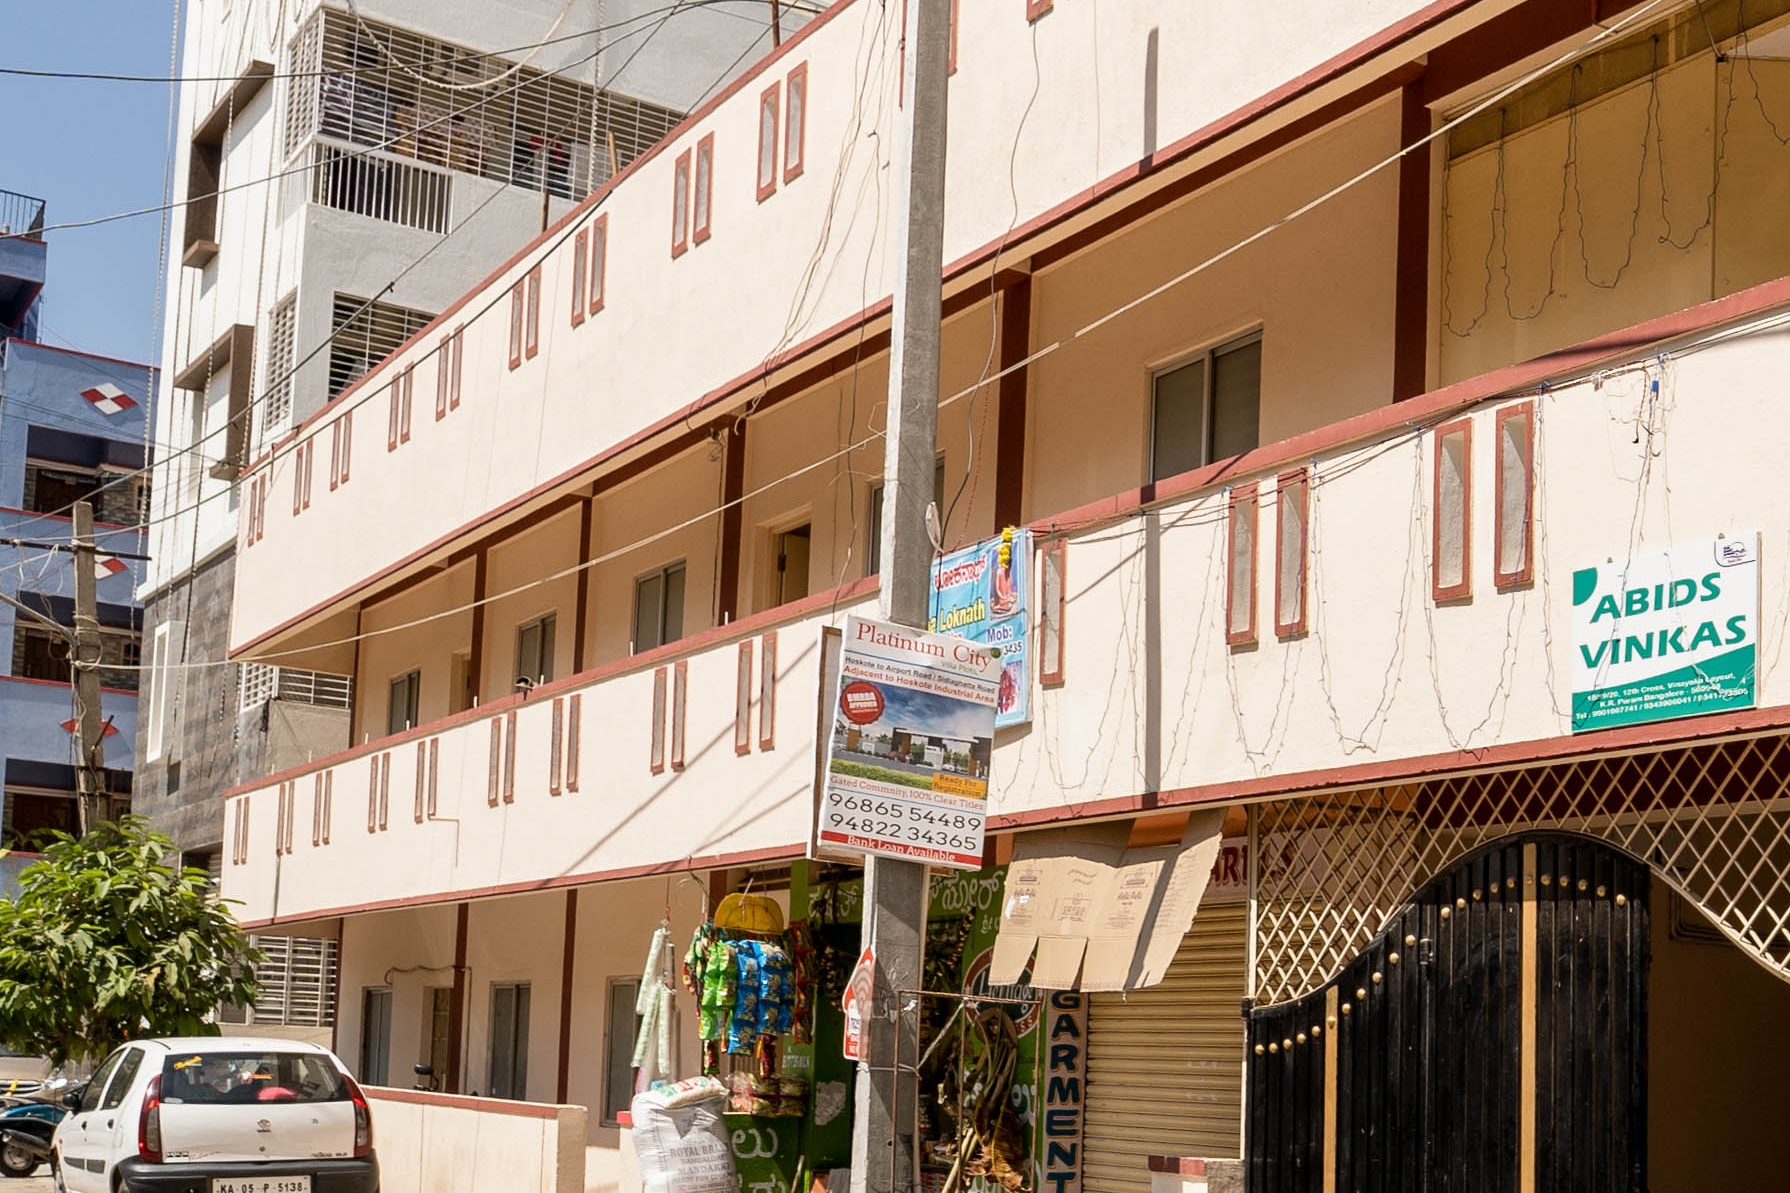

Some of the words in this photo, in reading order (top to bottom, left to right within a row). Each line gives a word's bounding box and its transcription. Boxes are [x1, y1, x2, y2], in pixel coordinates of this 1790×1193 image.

[940, 599, 985, 632] Loknath
[1589, 572, 1721, 624] ABIDS
[856, 621, 945, 658] Platinum
[953, 644, 992, 673] City
[987, 625, 1012, 643] Mob:
[1579, 615, 1746, 669] VINKAS
[844, 665, 883, 679] Adjacent
[886, 673, 894, 681] to
[897, 676, 932, 689] Hoskote
[934, 683, 974, 699] Industrial
[975, 692, 994, 703] Area
[845, 656, 875, 667] Hoskote
[886, 665, 911, 675] Airport
[913, 670, 932, 679] Road
[976, 684, 995, 693] Road
[829, 792, 903, 818] 96865
[909, 807, 981, 831] 54489
[830, 776, 858, 788] Gated
[909, 789, 932, 802] 100%
[934, 793, 957, 806] Clear
[959, 799, 984, 810] Titles
[830, 813, 901, 838] 94822
[907, 826, 976, 851] 34365
[847, 836, 875, 849] Bank
[877, 840, 904, 853] Loan
[906, 845, 956, 862] Available
[220, 1184, 234, 1193] KA
[241, 1184, 254, 1193] 05
[263, 1183, 270, 1193] P
[277, 1182, 302, 1192] 5138
